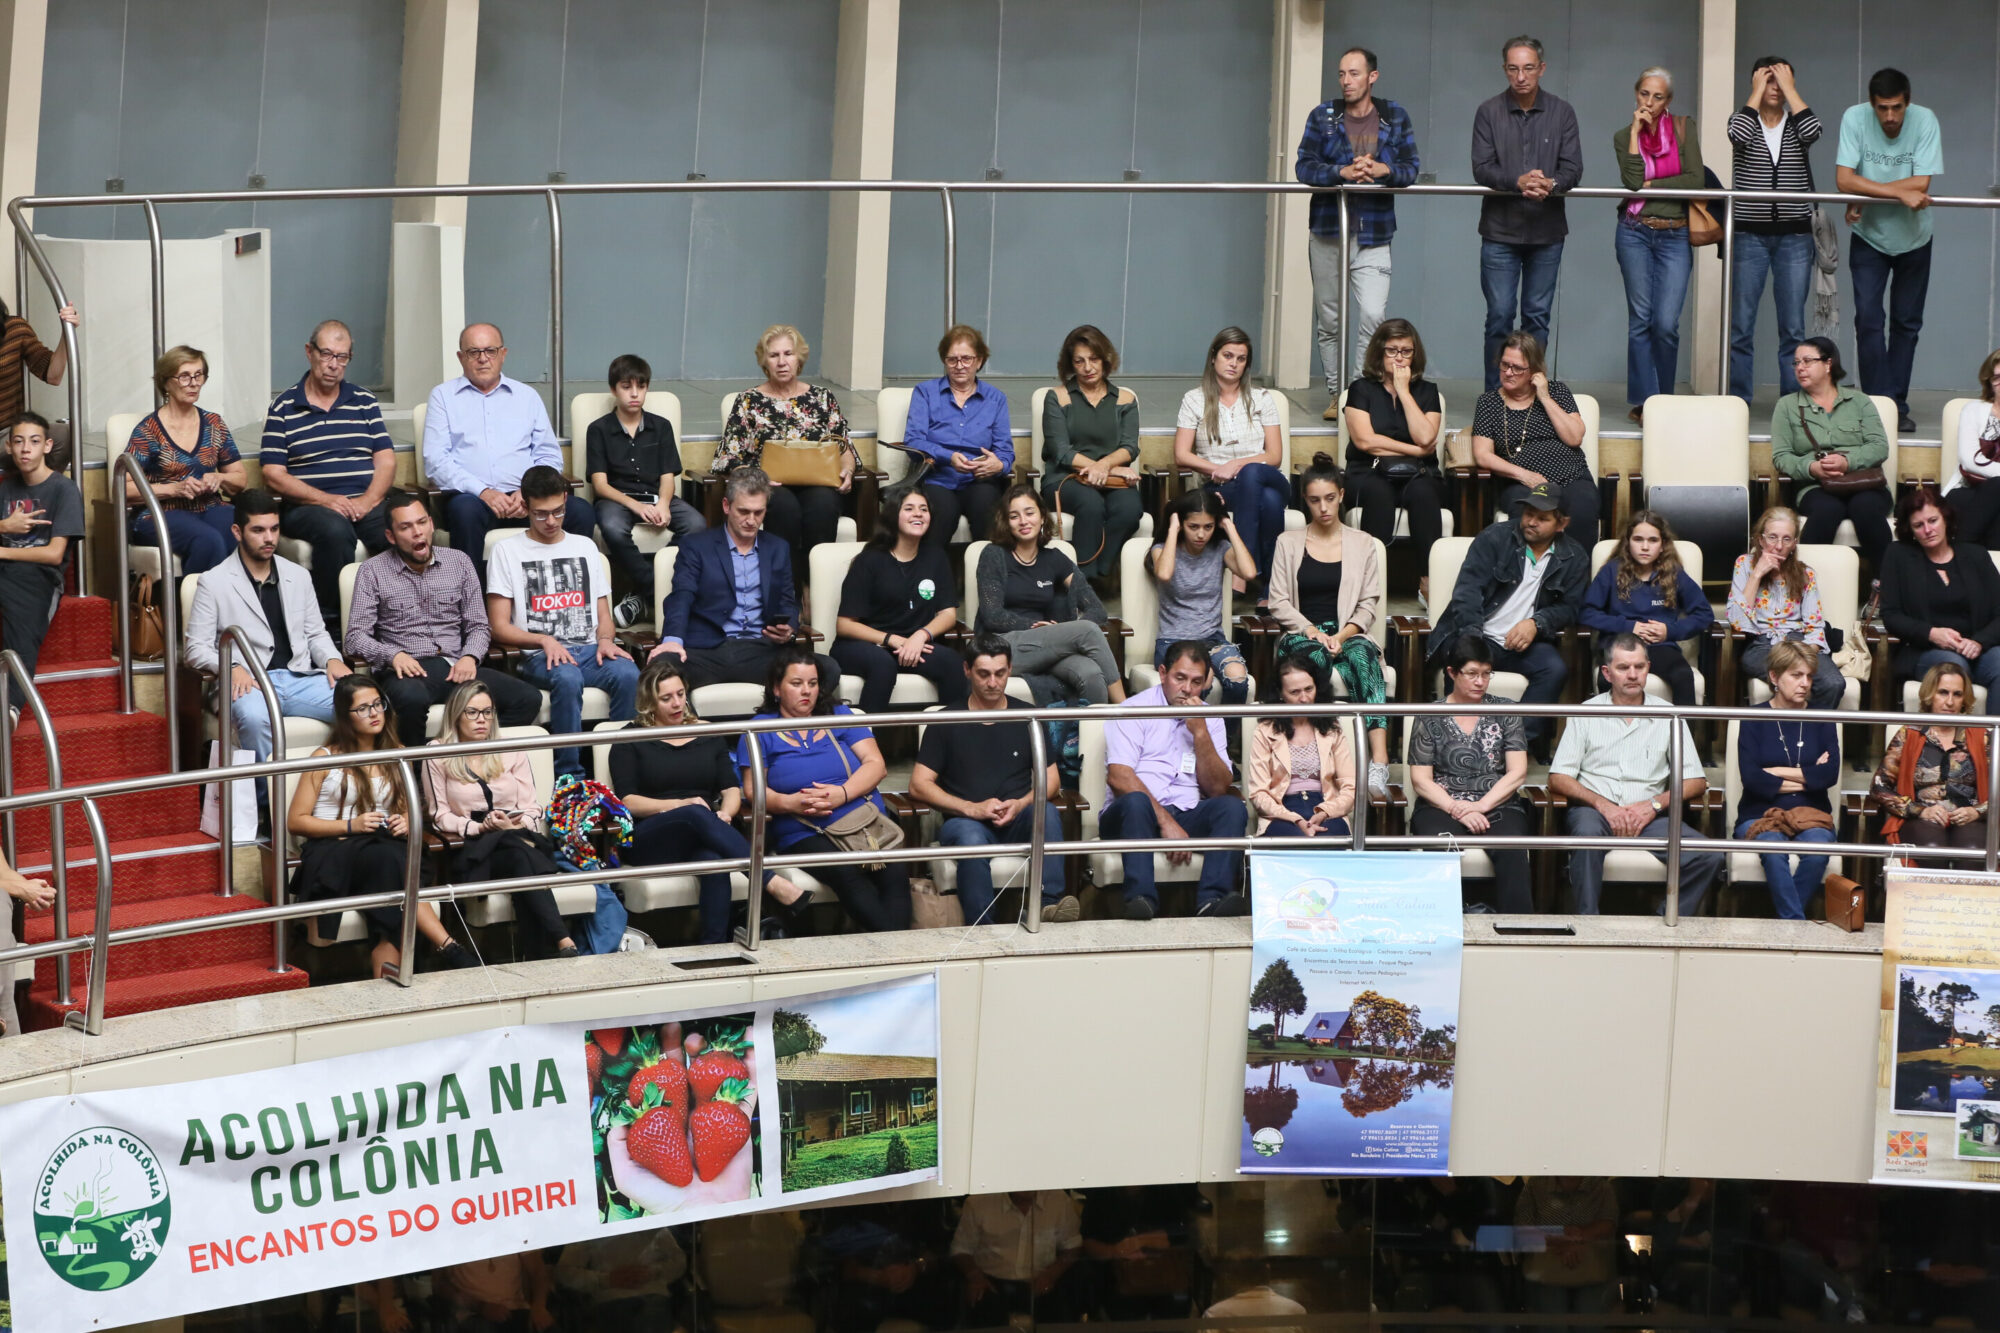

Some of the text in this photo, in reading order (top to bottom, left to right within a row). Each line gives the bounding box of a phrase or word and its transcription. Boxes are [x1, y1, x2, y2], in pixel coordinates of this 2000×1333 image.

[535, 592, 582, 610] TOKYO
[181, 1058, 566, 1165] ACOLHIDA NA
[40, 1135, 161, 1210] ACOLHIDA NA COLÔNIA
[251, 1128, 502, 1213] COLÔNIA
[188, 1179, 577, 1273] ENCANTOS DO QUIRIRI
